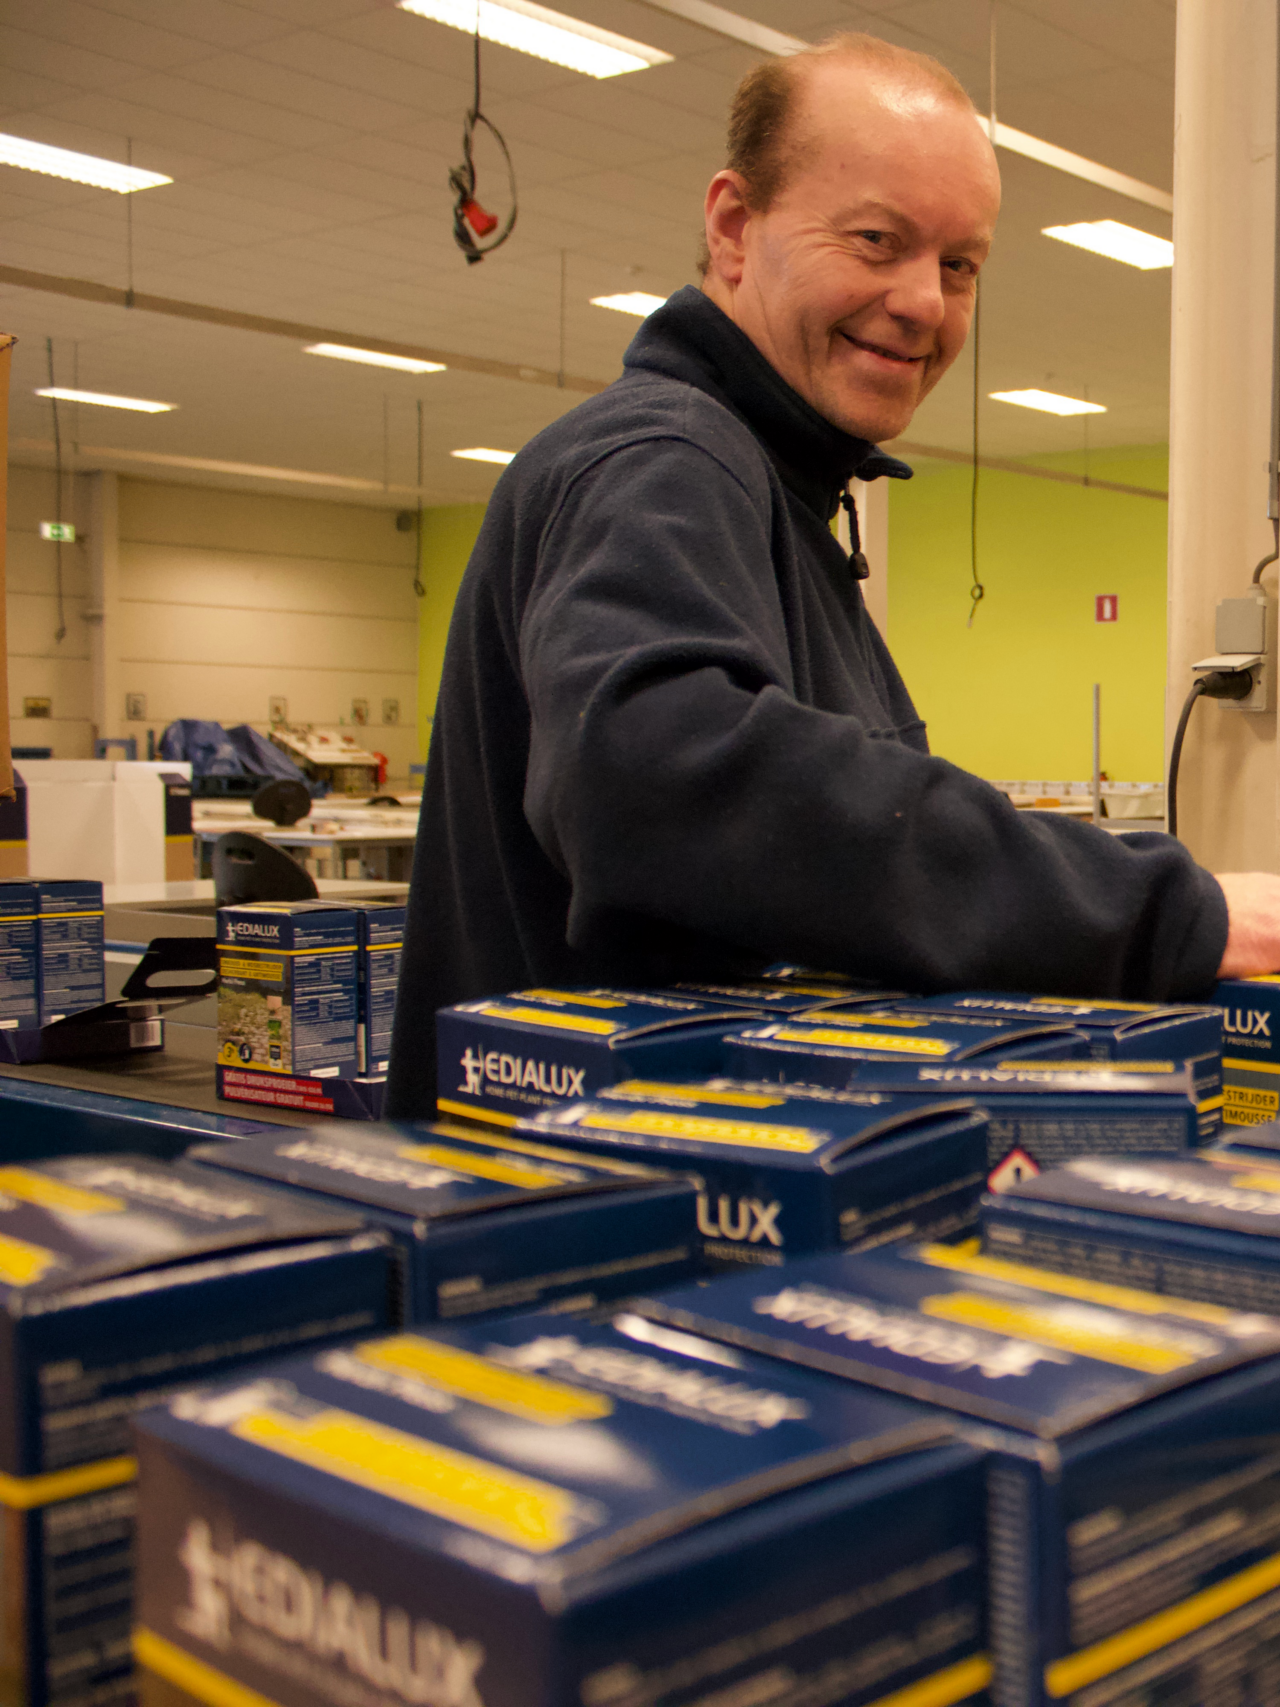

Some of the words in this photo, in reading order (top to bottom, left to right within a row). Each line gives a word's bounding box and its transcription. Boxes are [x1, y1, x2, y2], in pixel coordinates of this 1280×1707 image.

[237, 922, 279, 937] EDIALUX
[485, 1050, 586, 1097] EDIALUX
[1223, 1089, 1276, 1107] STRIJDER
